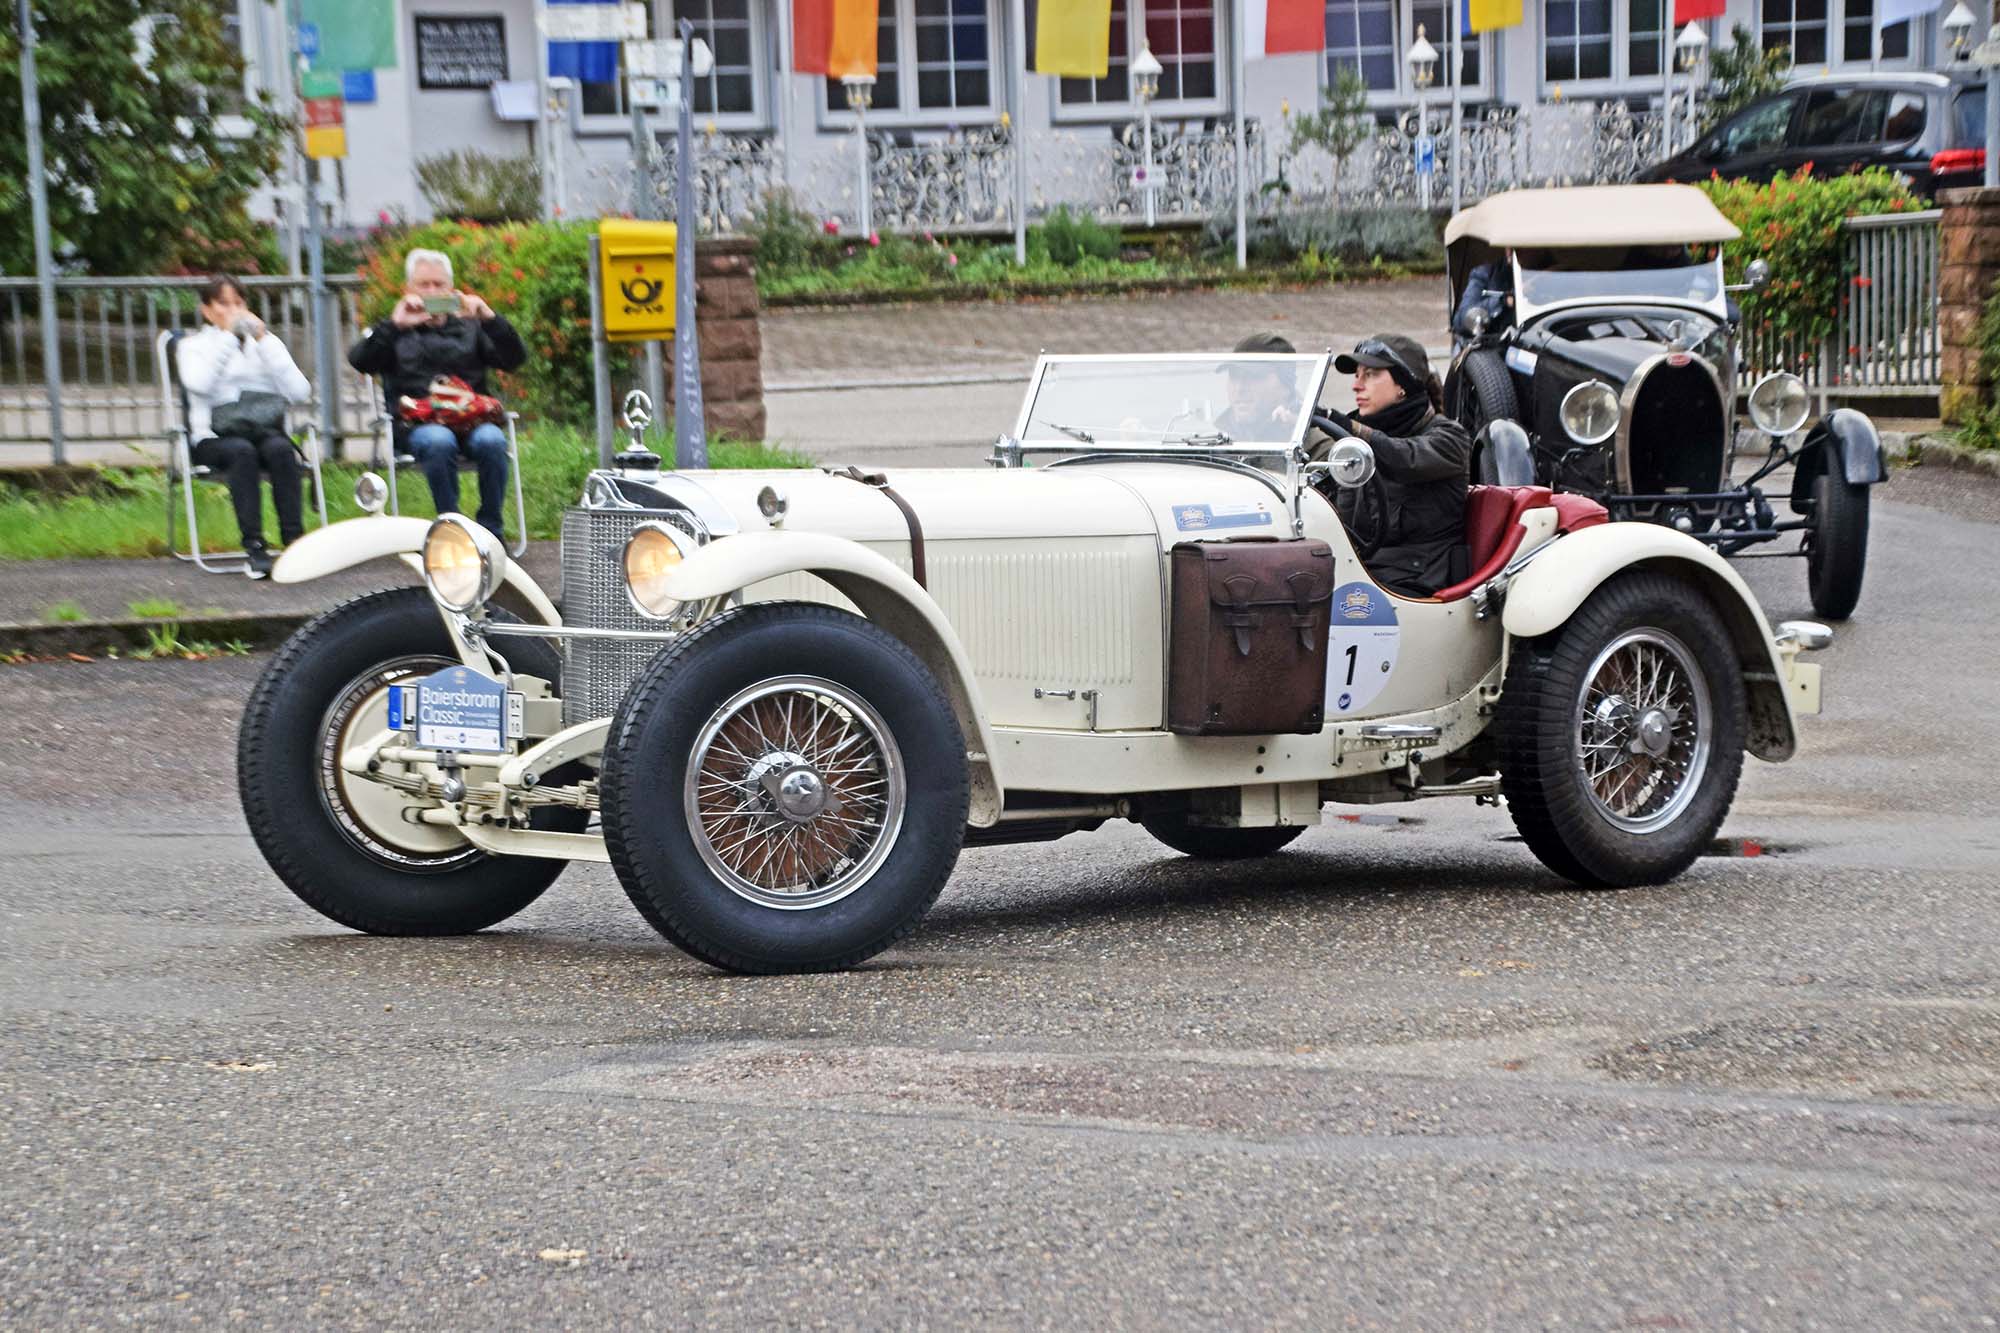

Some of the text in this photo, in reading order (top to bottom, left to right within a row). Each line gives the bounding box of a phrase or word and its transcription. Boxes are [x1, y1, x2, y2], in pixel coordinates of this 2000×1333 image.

[1345, 644, 1358, 686] 1
[421, 686, 500, 709] Baiersbronn
[421, 705, 465, 726] Classic
